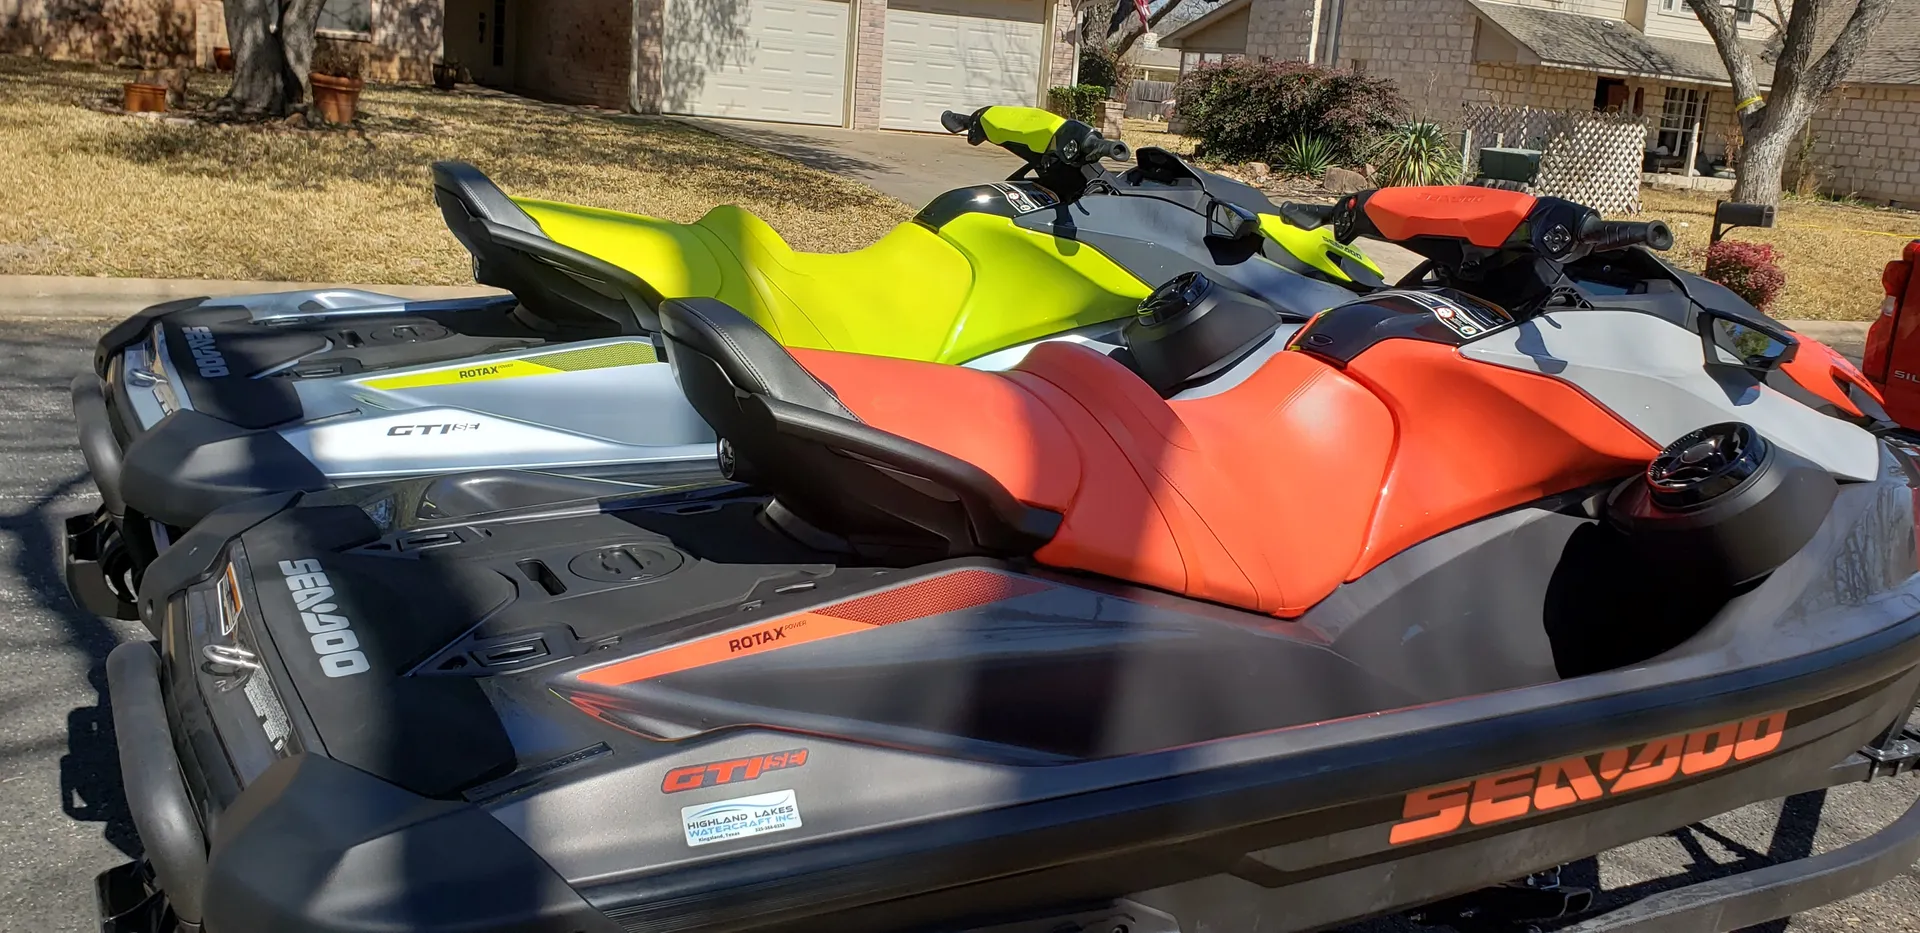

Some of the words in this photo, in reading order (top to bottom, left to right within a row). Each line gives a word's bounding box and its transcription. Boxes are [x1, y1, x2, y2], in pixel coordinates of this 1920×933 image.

[459, 366, 499, 379] ROTAX
[729, 627, 786, 652] ROTAX
[784, 620, 807, 631] POWER
[687, 813, 748, 830] HIGHLAND
[754, 805, 794, 818] LAKES
[688, 817, 772, 838] WATERCRAFT
[776, 812, 798, 823] INC.
